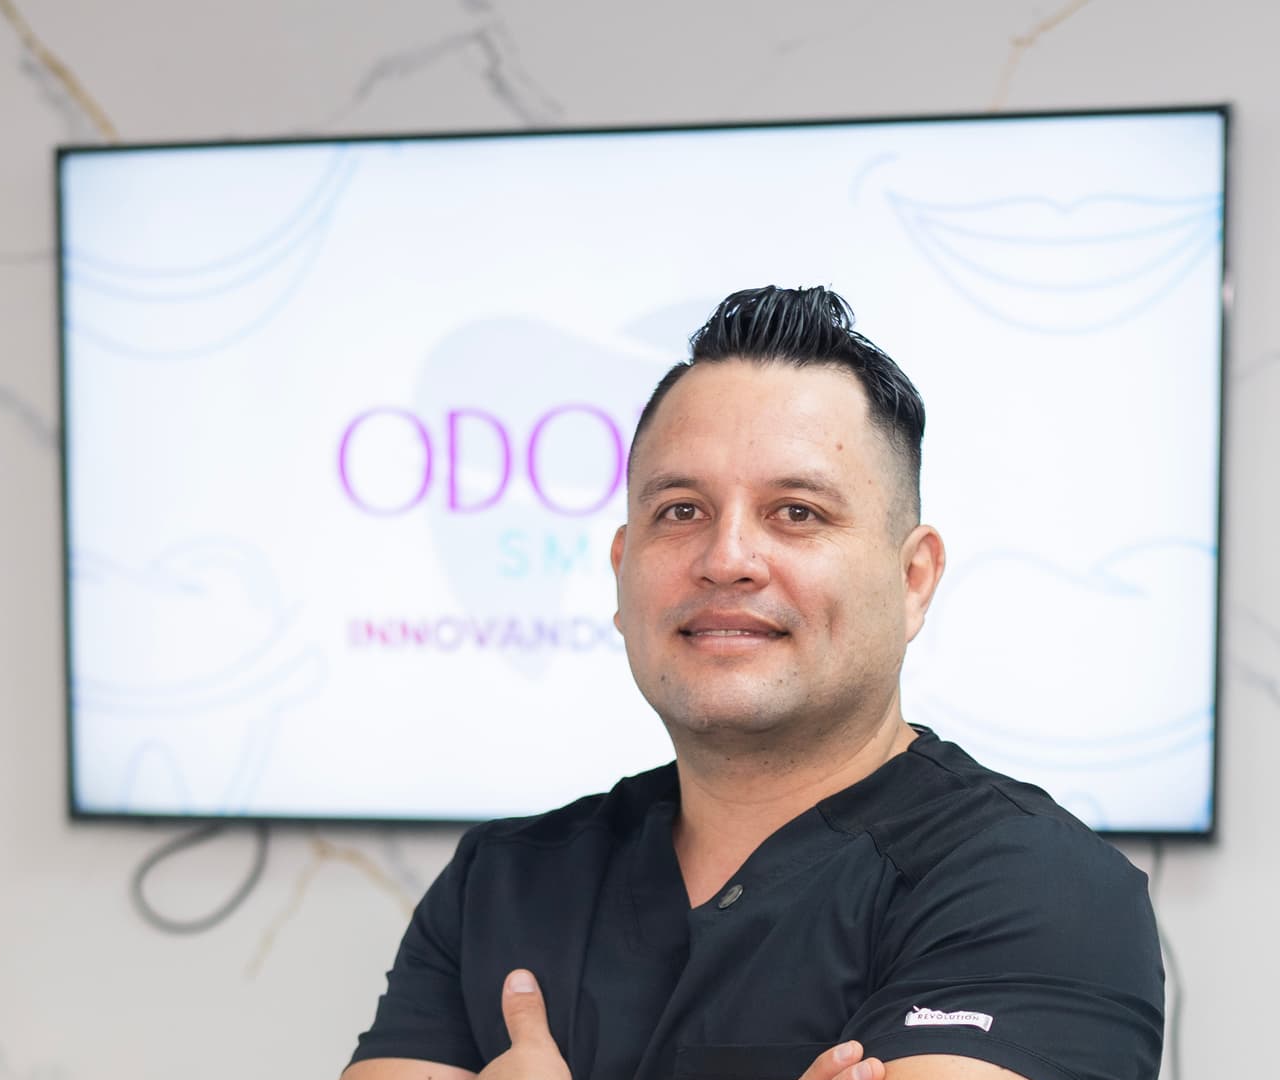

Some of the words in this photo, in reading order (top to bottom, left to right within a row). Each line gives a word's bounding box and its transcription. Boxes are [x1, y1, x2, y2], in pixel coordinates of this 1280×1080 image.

[337, 403, 646, 517] ODO
[498, 528, 617, 579] SM
[917, 1012, 980, 1022] REVOLUTION
